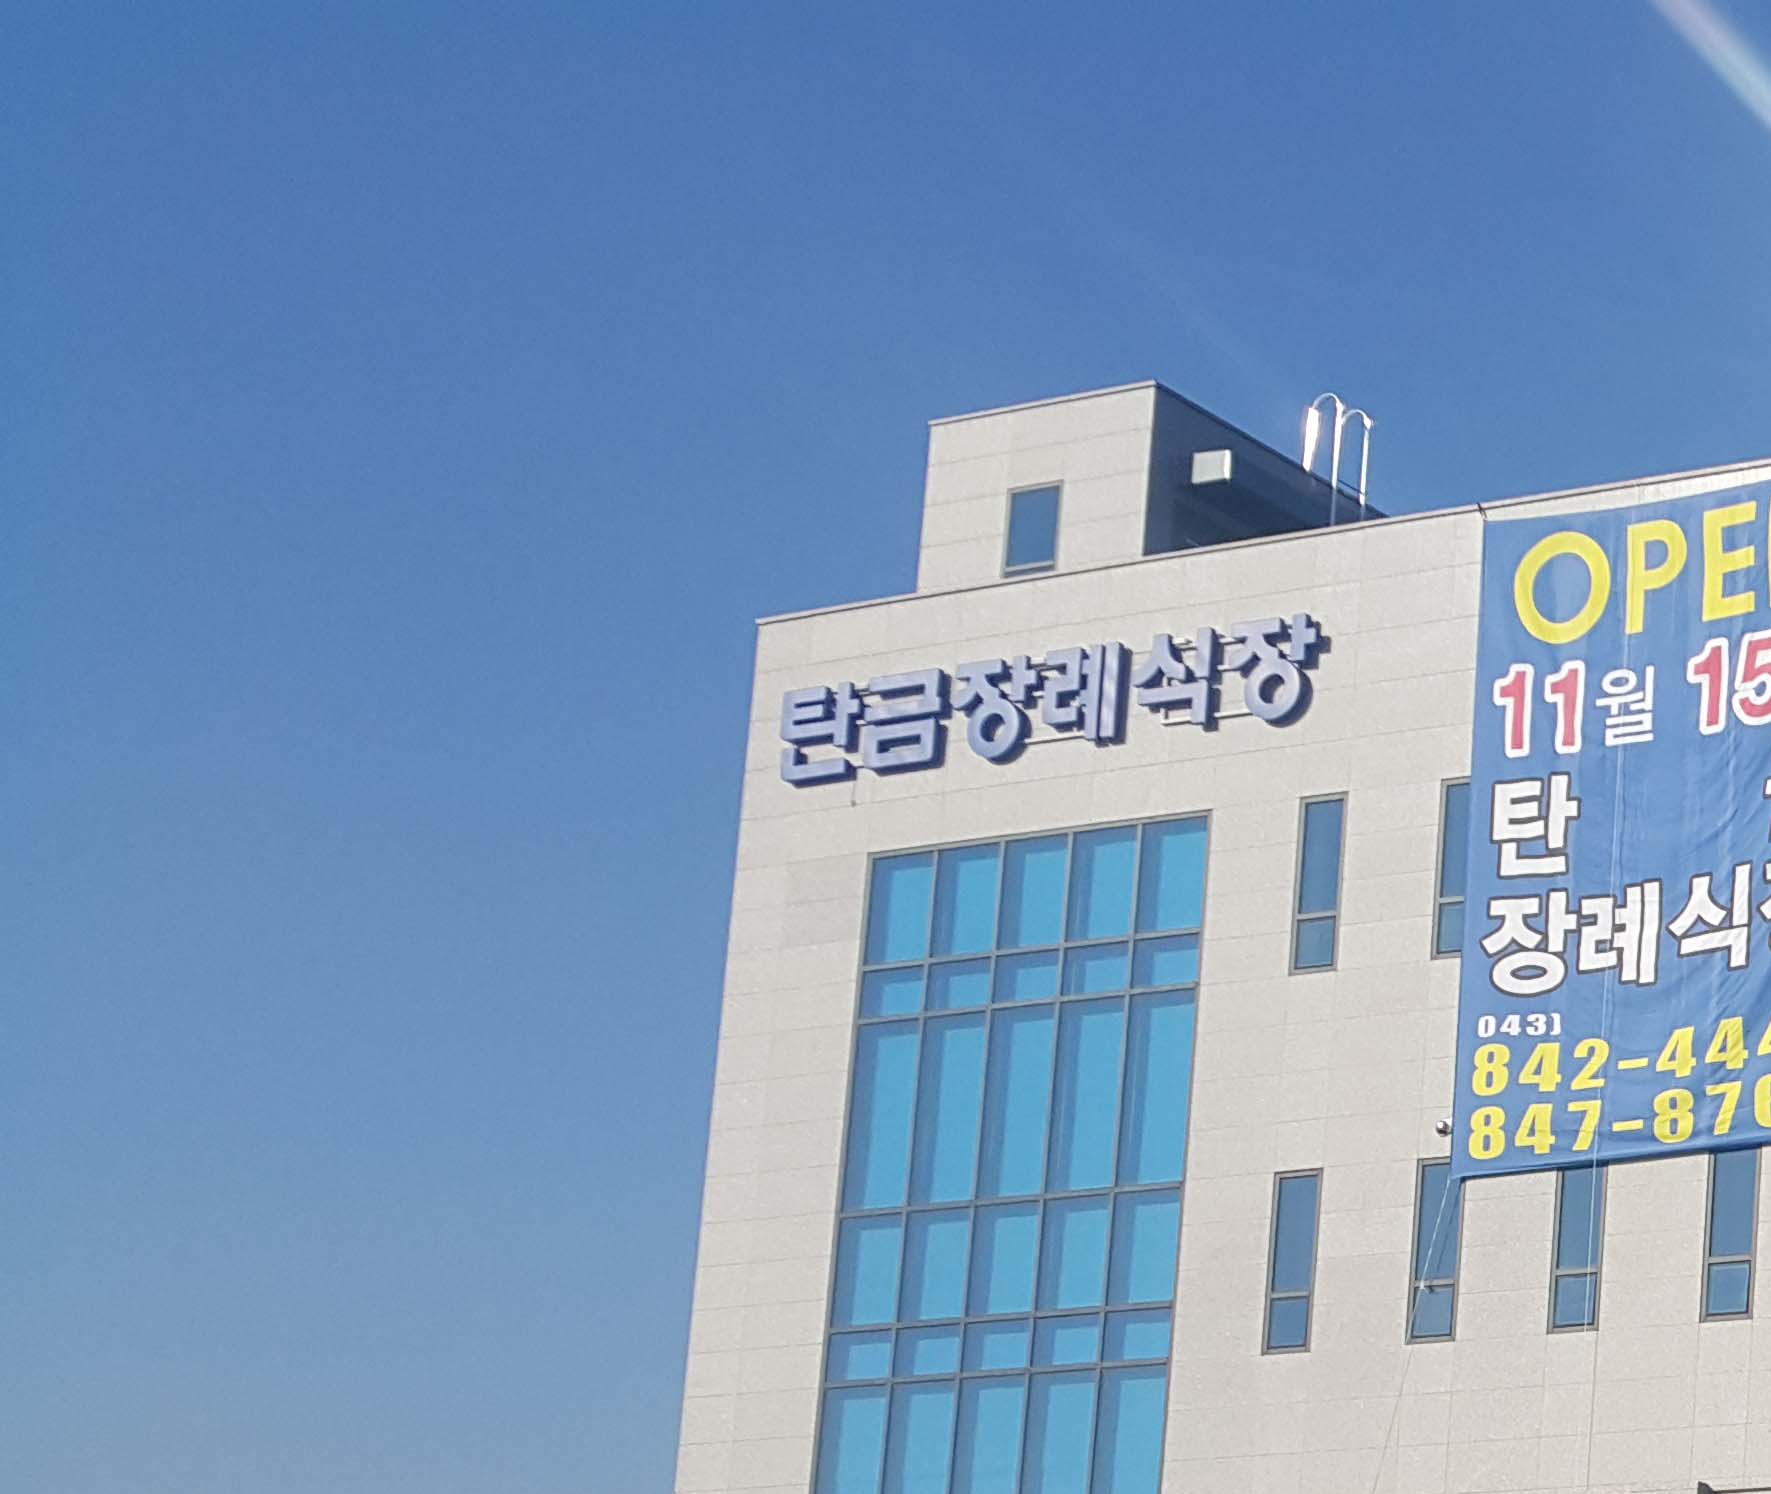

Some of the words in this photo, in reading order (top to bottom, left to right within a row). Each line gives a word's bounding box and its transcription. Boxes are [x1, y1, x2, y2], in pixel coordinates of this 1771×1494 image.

[780, 612, 1322, 787] 탄금장례식장
[1493, 660, 1655, 758] 11월
[1476, 1011, 1561, 1037] 043)
